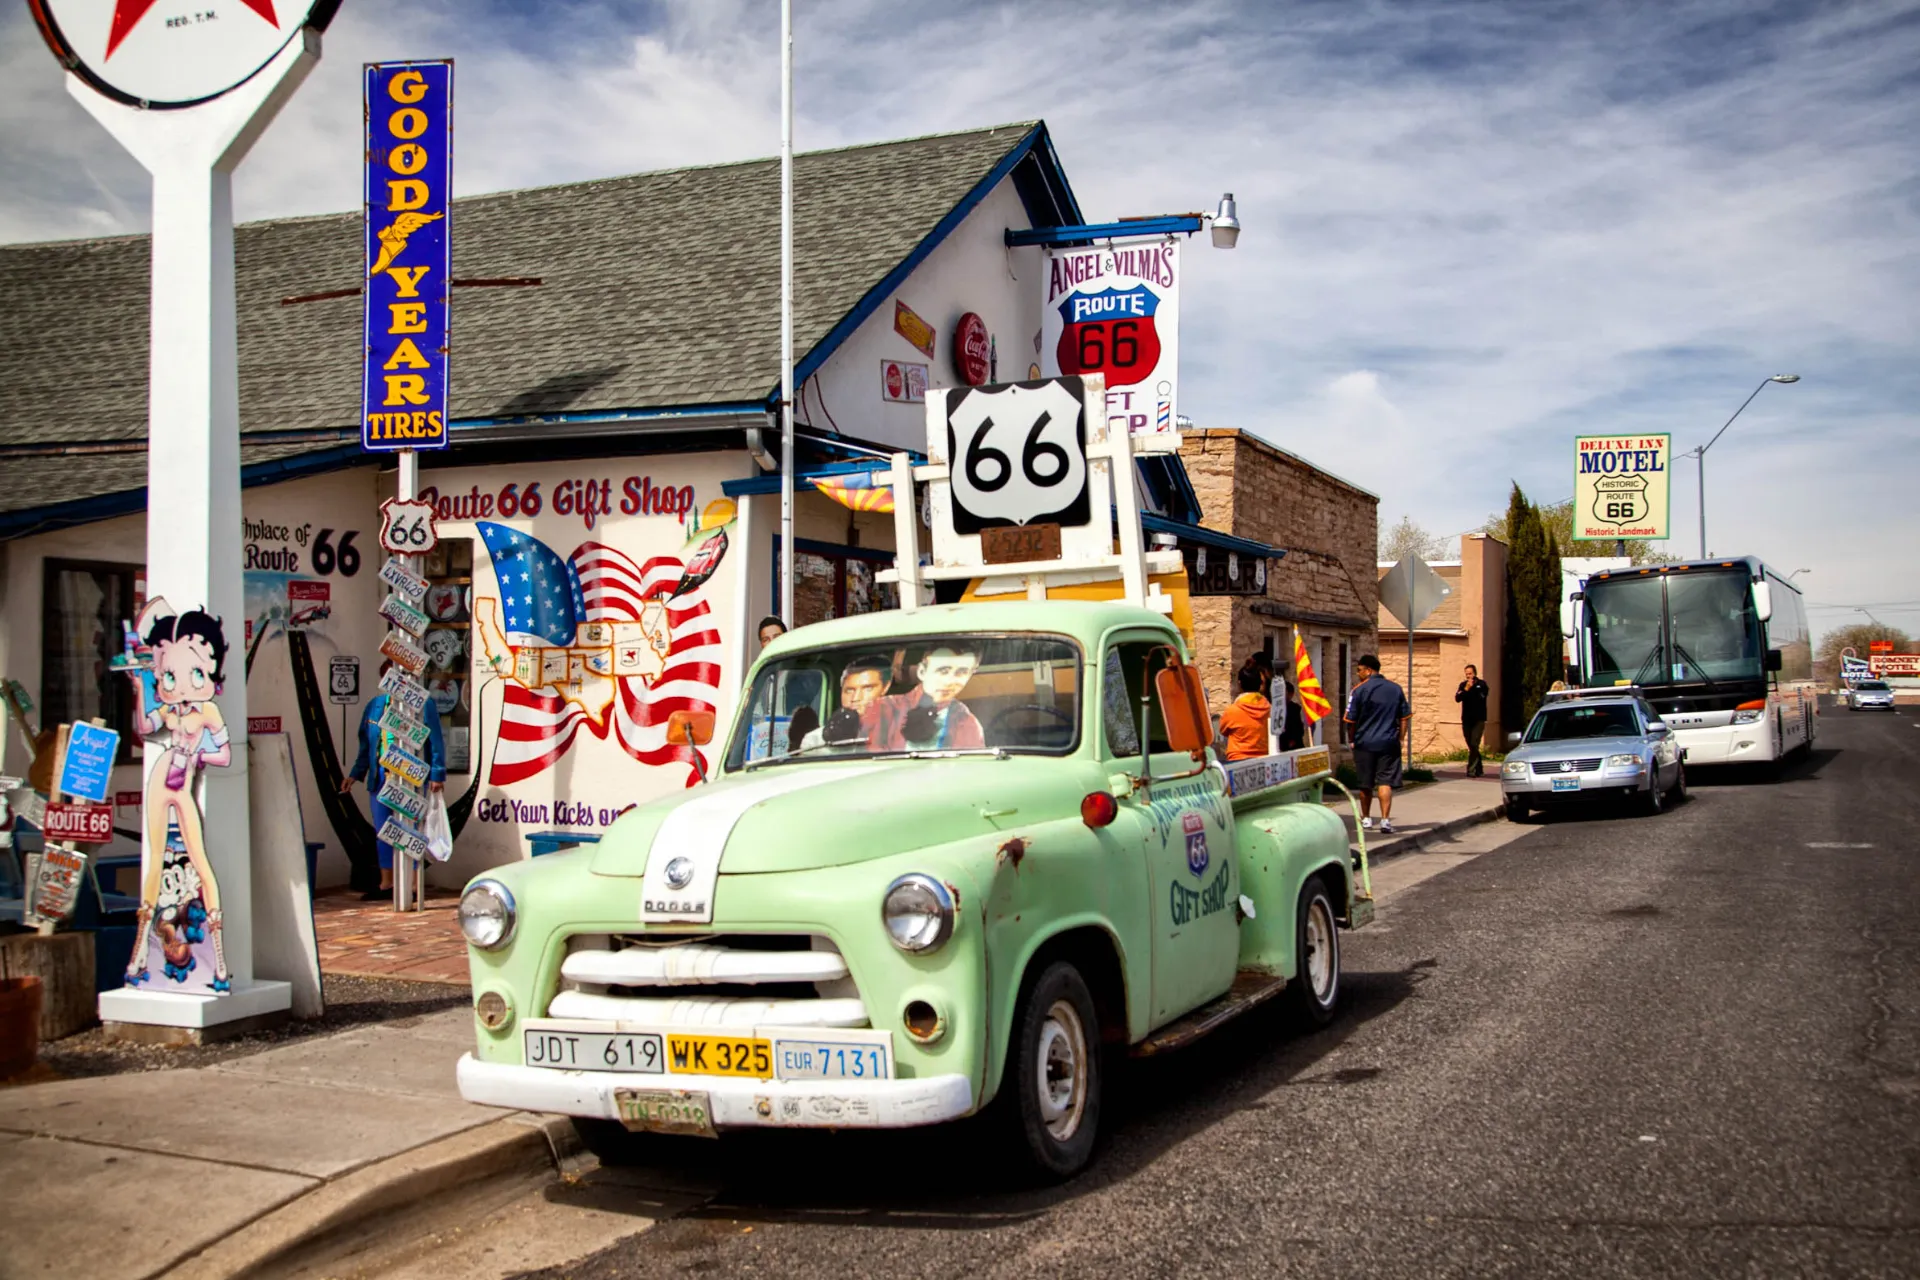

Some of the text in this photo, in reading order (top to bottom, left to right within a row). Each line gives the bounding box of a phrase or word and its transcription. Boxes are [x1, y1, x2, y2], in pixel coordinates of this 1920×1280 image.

[166, 15, 192, 29] REG.
[1048, 242, 1175, 304] ANGEL & VILMA'S
[1074, 293, 1145, 322] ROUTE
[1079, 321, 1139, 370] 66
[368, 410, 443, 440] TIRES
[965, 409, 1070, 493] 66
[1580, 439, 1664, 451] DELUXE INN
[1579, 450, 1664, 474] MOTEL
[1602, 480, 1639, 489] HISTORIC
[1606, 492, 1635, 500] ROUTE
[497, 481, 543, 518] 66
[552, 478, 613, 531] Gift
[620, 475, 696, 525] Shop
[1607, 502, 1634, 518] 66
[243, 516, 313, 548] hplace of
[390, 514, 428, 546] 66
[1585, 526, 1656, 536] Historic Landmark
[244, 543, 299, 572] Route
[311, 528, 362, 577] 66
[47, 809, 110, 833] ROUTE 66
[478, 798, 509, 823] Get
[510, 799, 549, 824] Your
[553, 800, 595, 826] Kicks
[405, 837, 425, 855] 188
[1171, 859, 1229, 926] GIFT SHOP
[532, 1036, 658, 1068] JDT 619
[670, 1038, 770, 1073] WK 325
[818, 1048, 878, 1078] 7131
